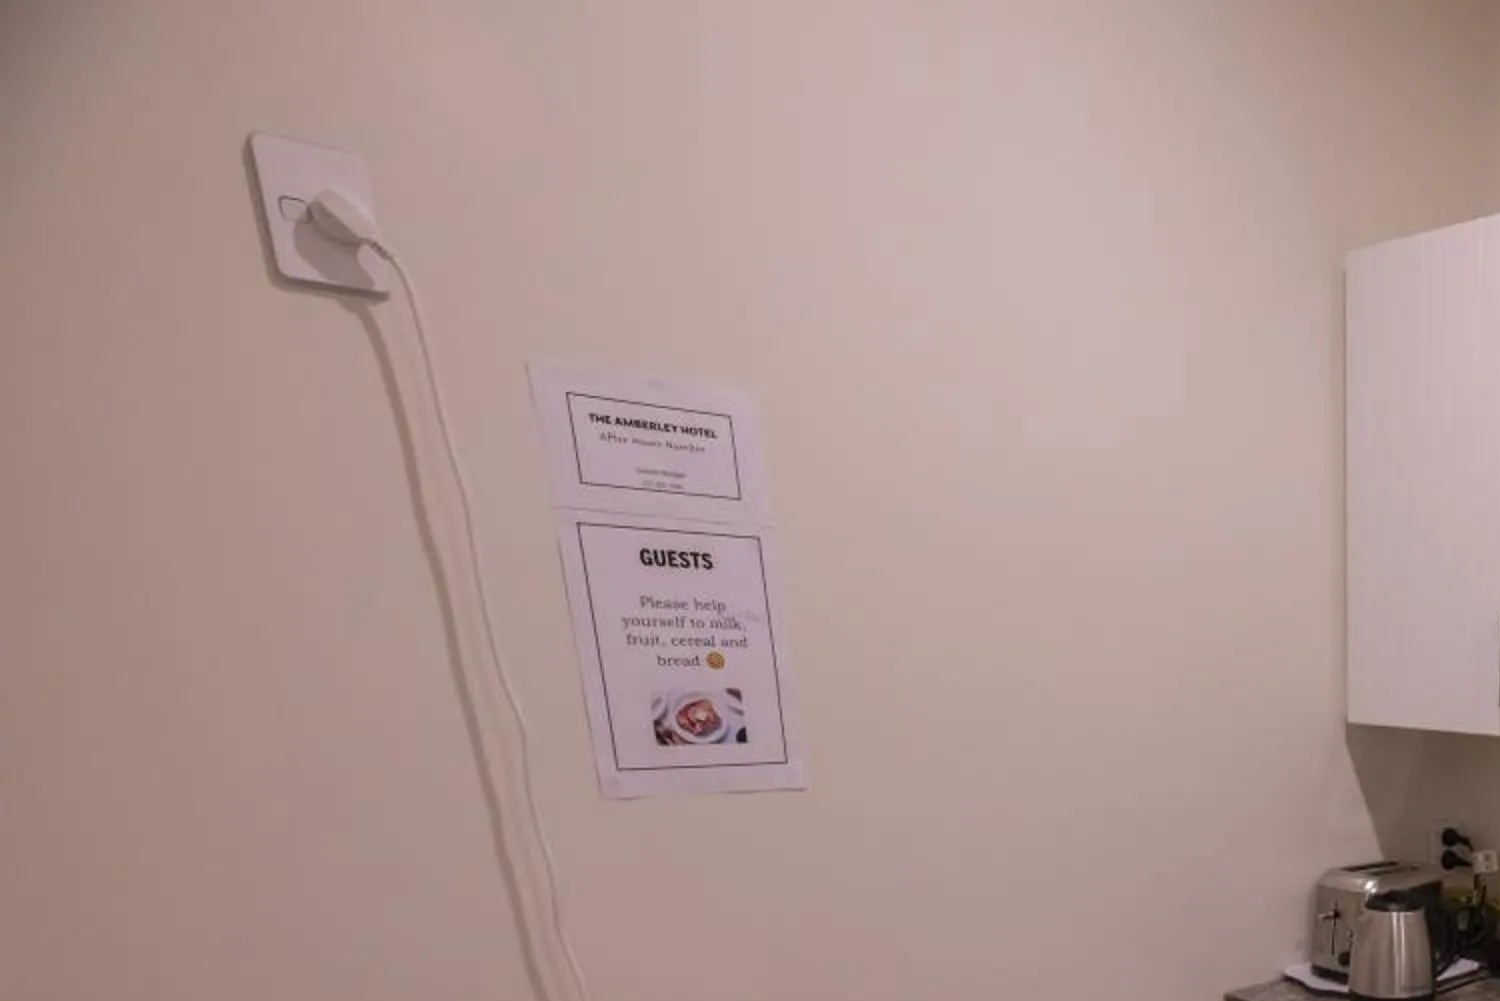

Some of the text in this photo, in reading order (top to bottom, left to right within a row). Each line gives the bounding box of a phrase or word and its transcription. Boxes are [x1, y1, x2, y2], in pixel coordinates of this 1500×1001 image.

[588, 412, 719, 439] THE AMBERLEY HOTEL
[639, 548, 714, 570] GUESTS
[639, 595, 727, 616] Please help
[621, 615, 687, 629] yourself
[690, 618, 706, 629] to
[626, 633, 748, 649] fruit, cereal and
